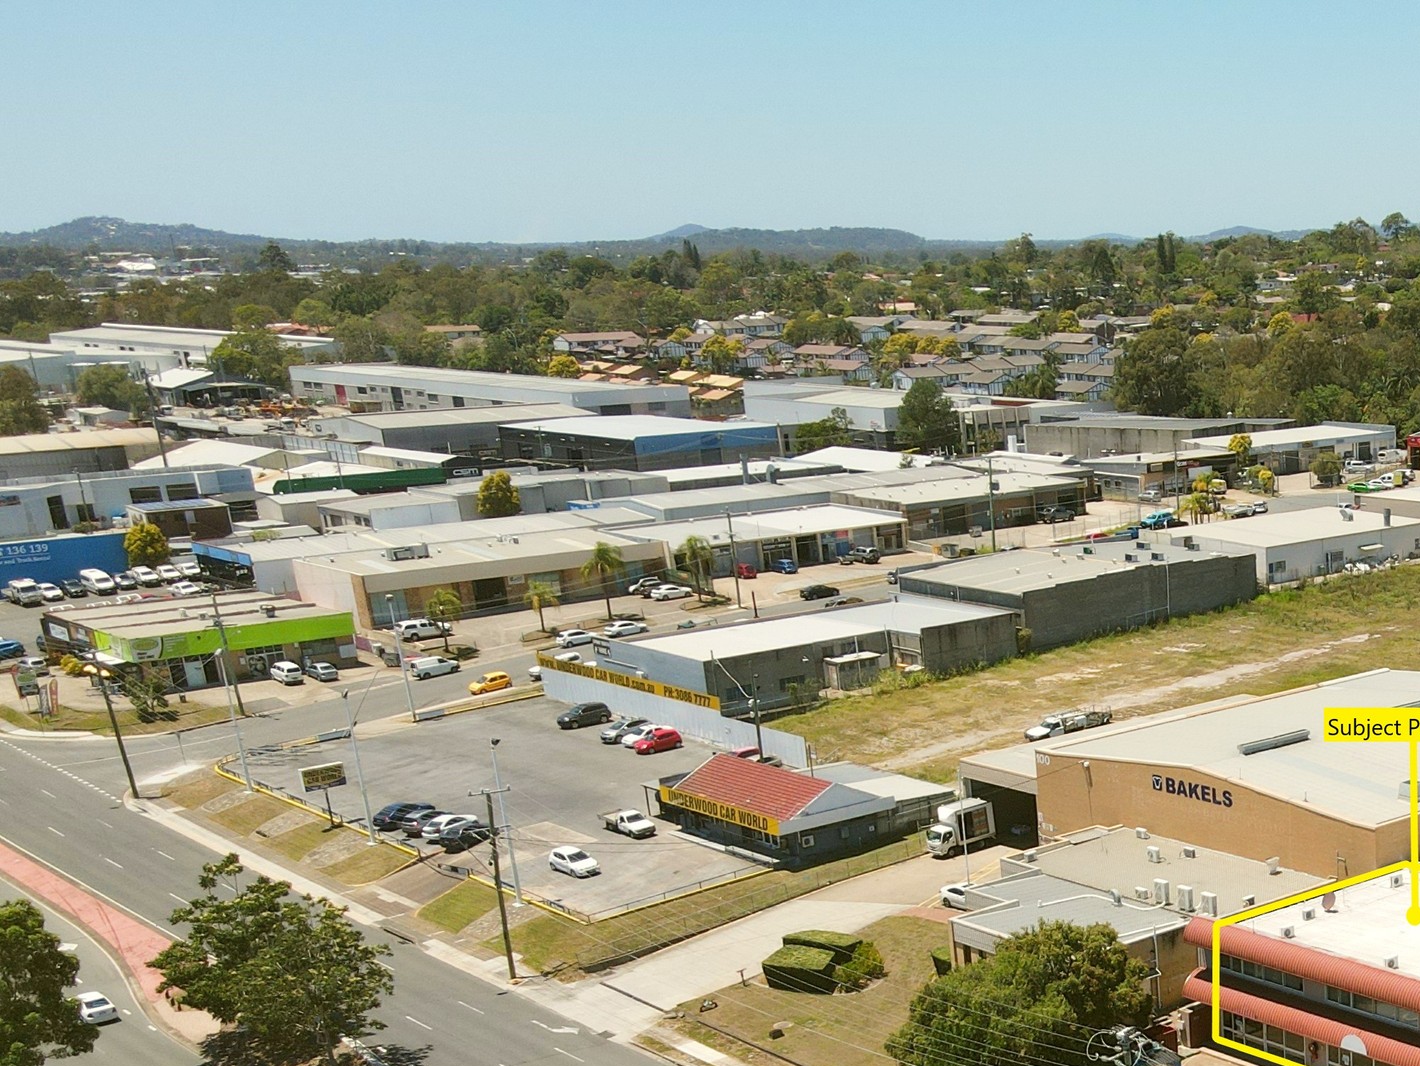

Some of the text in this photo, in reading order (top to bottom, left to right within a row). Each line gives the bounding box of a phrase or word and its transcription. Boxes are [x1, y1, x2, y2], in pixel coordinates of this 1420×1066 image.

[7, 544, 49, 555] 136 139
[1165, 777, 1233, 808] BAKELS
[668, 789, 768, 831] UNDERWOOD CAR WORLD
